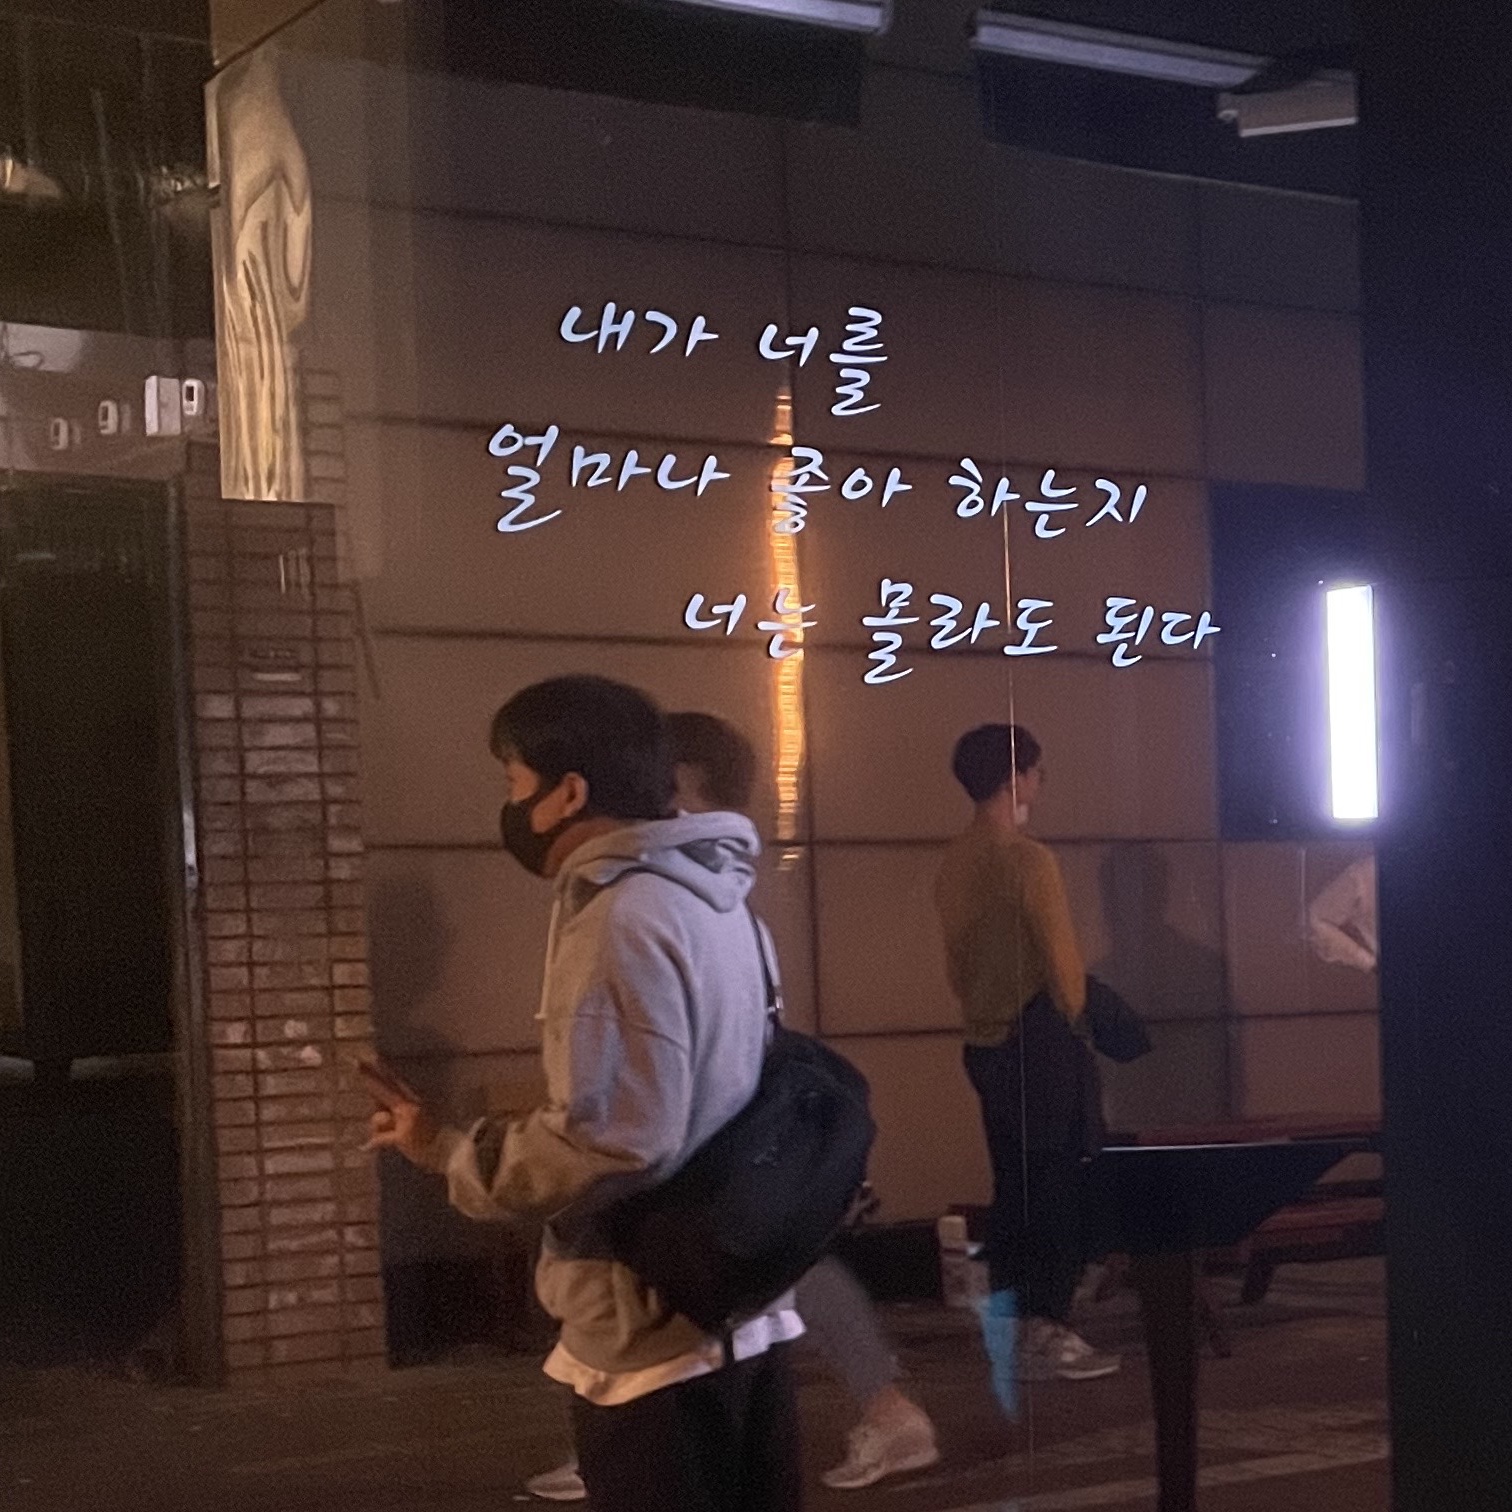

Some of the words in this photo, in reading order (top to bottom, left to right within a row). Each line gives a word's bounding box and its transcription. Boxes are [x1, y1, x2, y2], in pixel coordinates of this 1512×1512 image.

[560, 302, 721, 358] 내가
[759, 306, 889, 417] 너를
[488, 424, 732, 534] 얼마나
[771, 446, 914, 535] 좋아
[948, 457, 1149, 540] 하는지
[685, 587, 818, 660] 너는
[862, 578, 1060, 686] 몰라도
[1096, 597, 1223, 668] 된다
